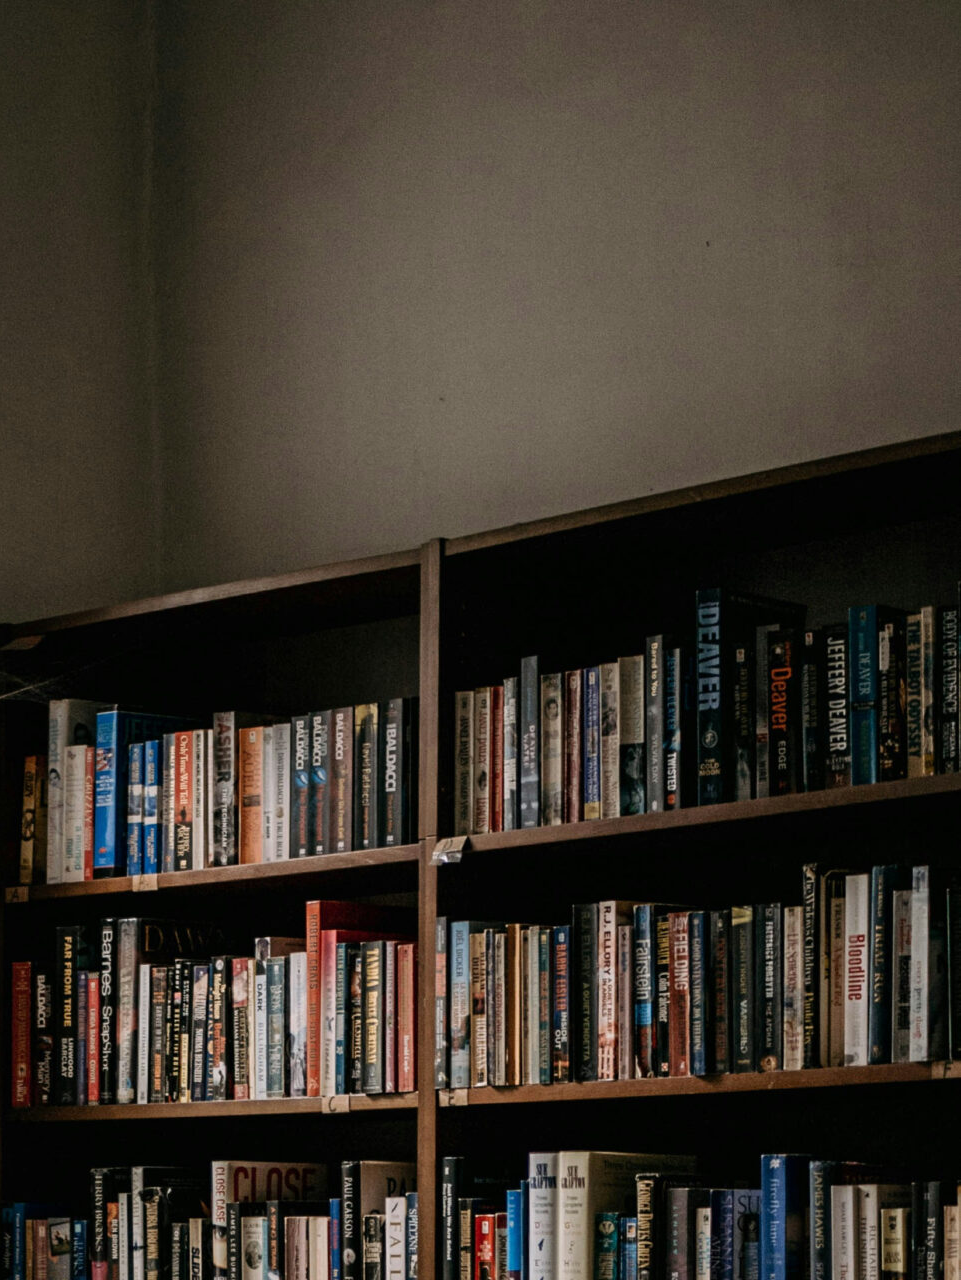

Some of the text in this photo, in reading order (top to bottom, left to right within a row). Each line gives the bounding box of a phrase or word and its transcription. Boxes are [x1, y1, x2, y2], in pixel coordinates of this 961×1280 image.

[698, 606, 720, 712] DEAVER
[770, 667, 792, 731] Deaver
[826, 636, 847, 752] JEFFERY DEAVER
[907, 621, 921, 757] THE TALBOT ODYSSEY
[217, 723, 231, 783] ASHER
[296, 720, 304, 770] BALDACCI
[312, 716, 322, 767] BALDACCI
[335, 713, 344, 760] BALDACCI
[385, 736, 396, 792] BALDACCI
[777, 739, 787, 770] EDGE
[179, 735, 189, 805] Only Time Will Tell
[666, 752, 676, 791] TWISTED
[102, 930, 113, 996] Barnes
[603, 906, 612, 975] R.J. ELLORY
[635, 939, 652, 1000] Fairstein
[674, 933, 688, 991] FIELDING
[847, 934, 865, 1001] Bloodline
[37, 974, 46, 1028] BALDACCI
[63, 936, 73, 1027] FAR FROM TRUE
[555, 944, 566, 1012] BARRY EISLER
[554, 1030, 562, 1050] OUT
[560, 1012, 568, 1043] INSIDE
[94, 1174, 104, 1253] TERRY BROOKS
[216, 1166, 225, 1223] CLOSE CASE
[344, 1177, 353, 1199] PAUL
[814, 1171, 824, 1249] JAMES HAWES
[344, 1201, 353, 1238] CARSON
[407, 1208, 417, 1254] SPILLANE
[926, 1217, 936, 1248] Fifty
